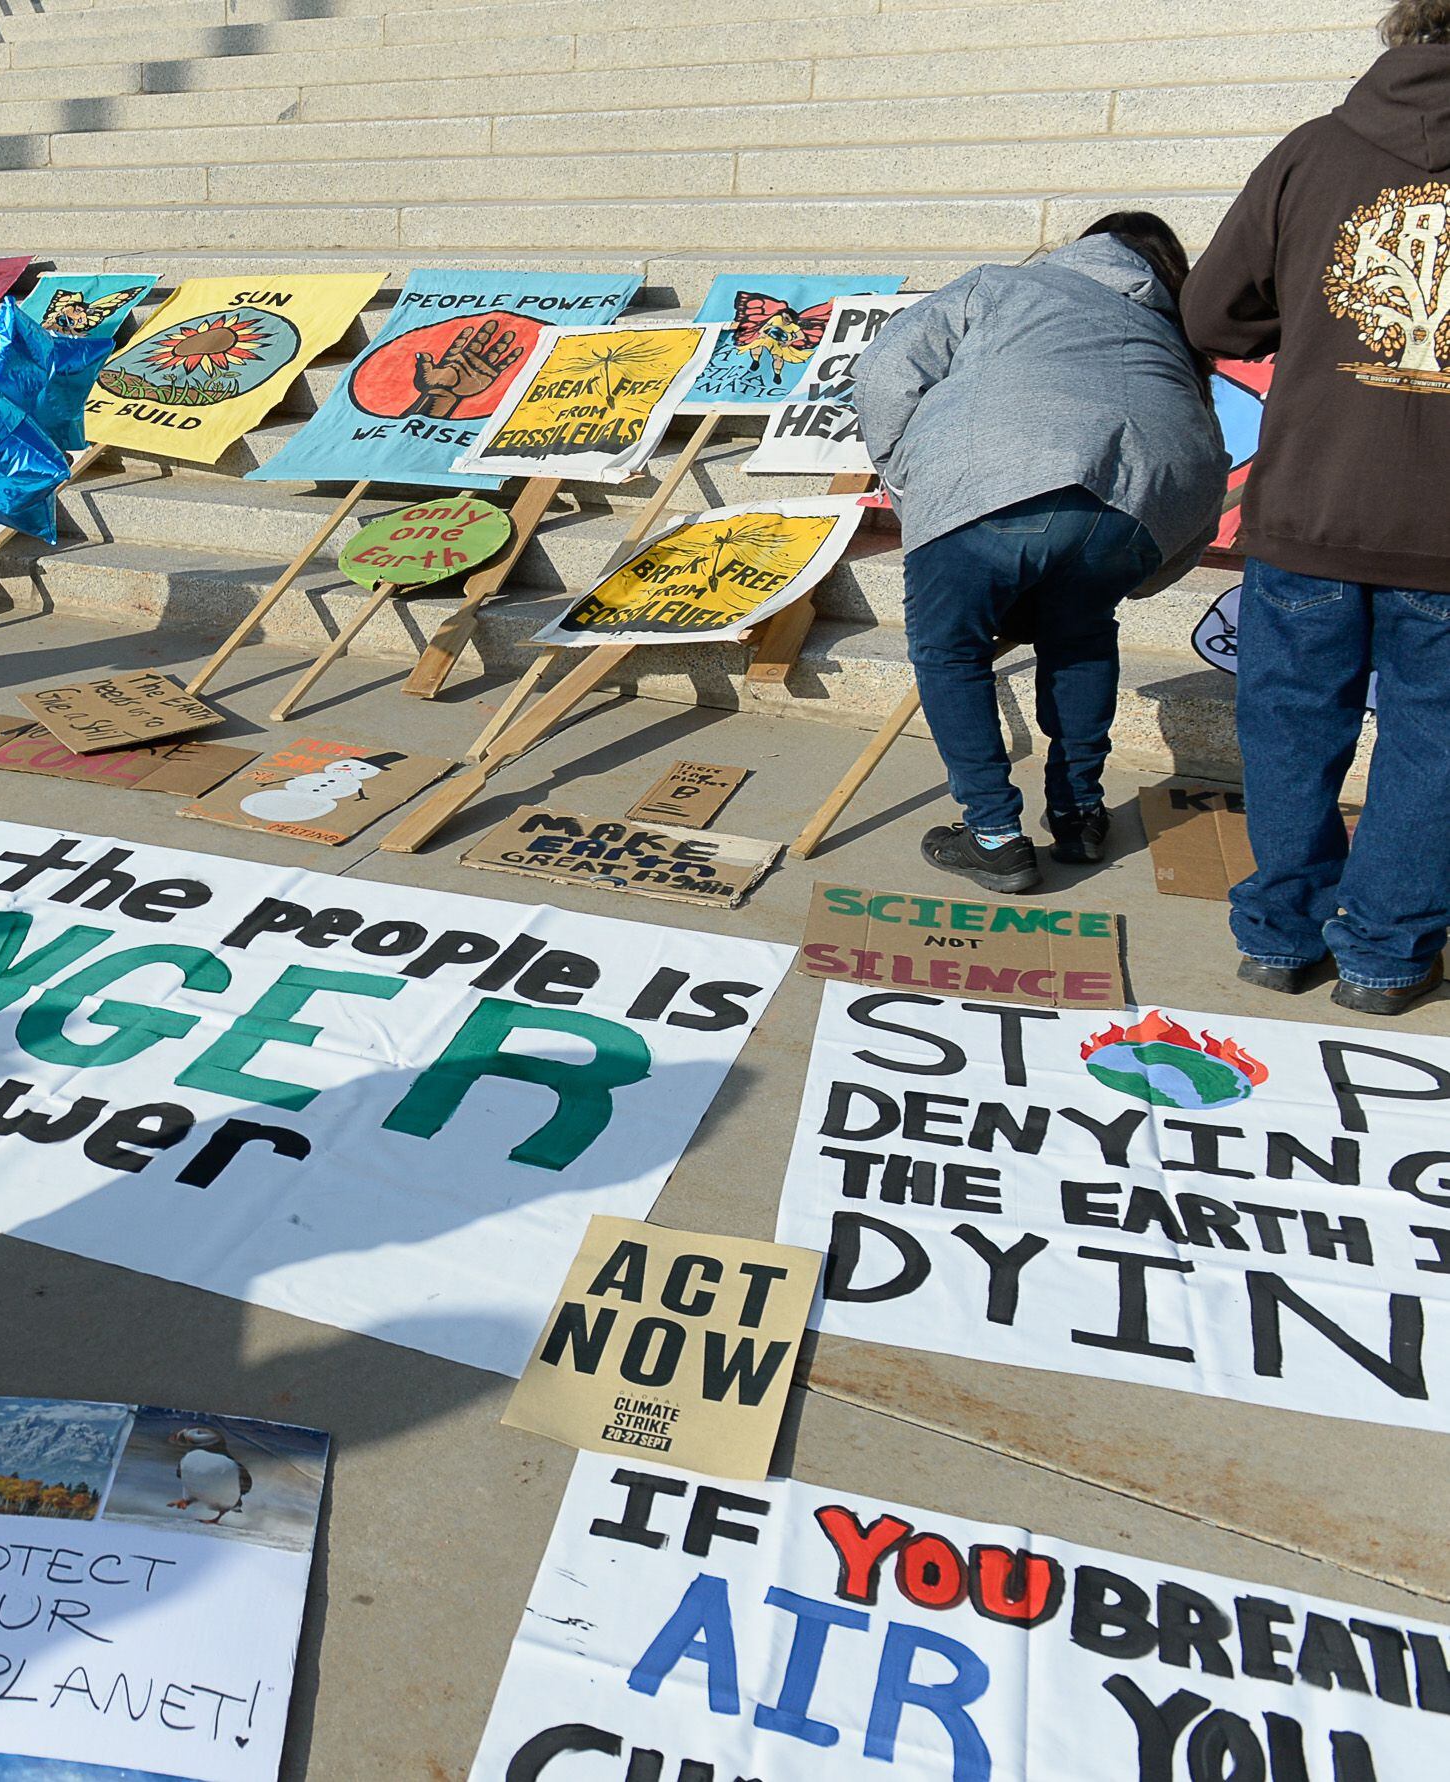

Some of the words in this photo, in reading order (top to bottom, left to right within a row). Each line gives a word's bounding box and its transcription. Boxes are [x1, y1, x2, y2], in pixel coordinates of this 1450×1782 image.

[228, 291, 293, 307] SUN
[401, 293, 511, 309] PEOPLE
[515, 293, 622, 310] POWER
[832, 307, 906, 343] PR
[696, 361, 767, 388] STICIA
[1410, 378, 1446, 389] COMMUNITY
[526, 375, 601, 403] BREAK
[611, 376, 666, 397] FREE
[116, 402, 202, 430] BUILD
[554, 405, 609, 422] FROM
[351, 424, 397, 441] WE
[399, 418, 479, 448] RISE
[488, 421, 571, 448] FOSSIL
[568, 417, 644, 446] FUELS
[400, 500, 495, 526] only
[389, 524, 464, 542] one
[352, 545, 469, 568] Earth
[717, 557, 790, 592] FREE
[88, 678, 142, 707] needs
[126, 673, 166, 698] The
[158, 696, 215, 721] EARTH
[63, 712, 89, 721] a
[679, 762, 724, 775] There
[670, 785, 701, 800] B
[268, 822, 340, 843] MELTING
[517, 813, 720, 863] MAKE
[500, 850, 629, 876] GREAT
[823, 888, 1112, 938] SCIENCE
[220, 895, 603, 1005] people
[923, 935, 986, 950] NOT
[803, 943, 1113, 1001] SILENCE
[818, 1146, 1003, 1215] THE
[1059, 1180, 1375, 1267] EARTH
[586, 1239, 789, 1329] ACT
[539, 1300, 793, 1408] NOW
[613, 1396, 681, 1423] CLIMATE
[619, 1390, 681, 1408] GLOBAL
[613, 1412, 671, 1436] STRIKE
[639, 1433, 669, 1450] SEPT
[588, 1468, 772, 1558] IF
[814, 1504, 1064, 1631] YOU
[627, 1573, 992, 1782] AIR
